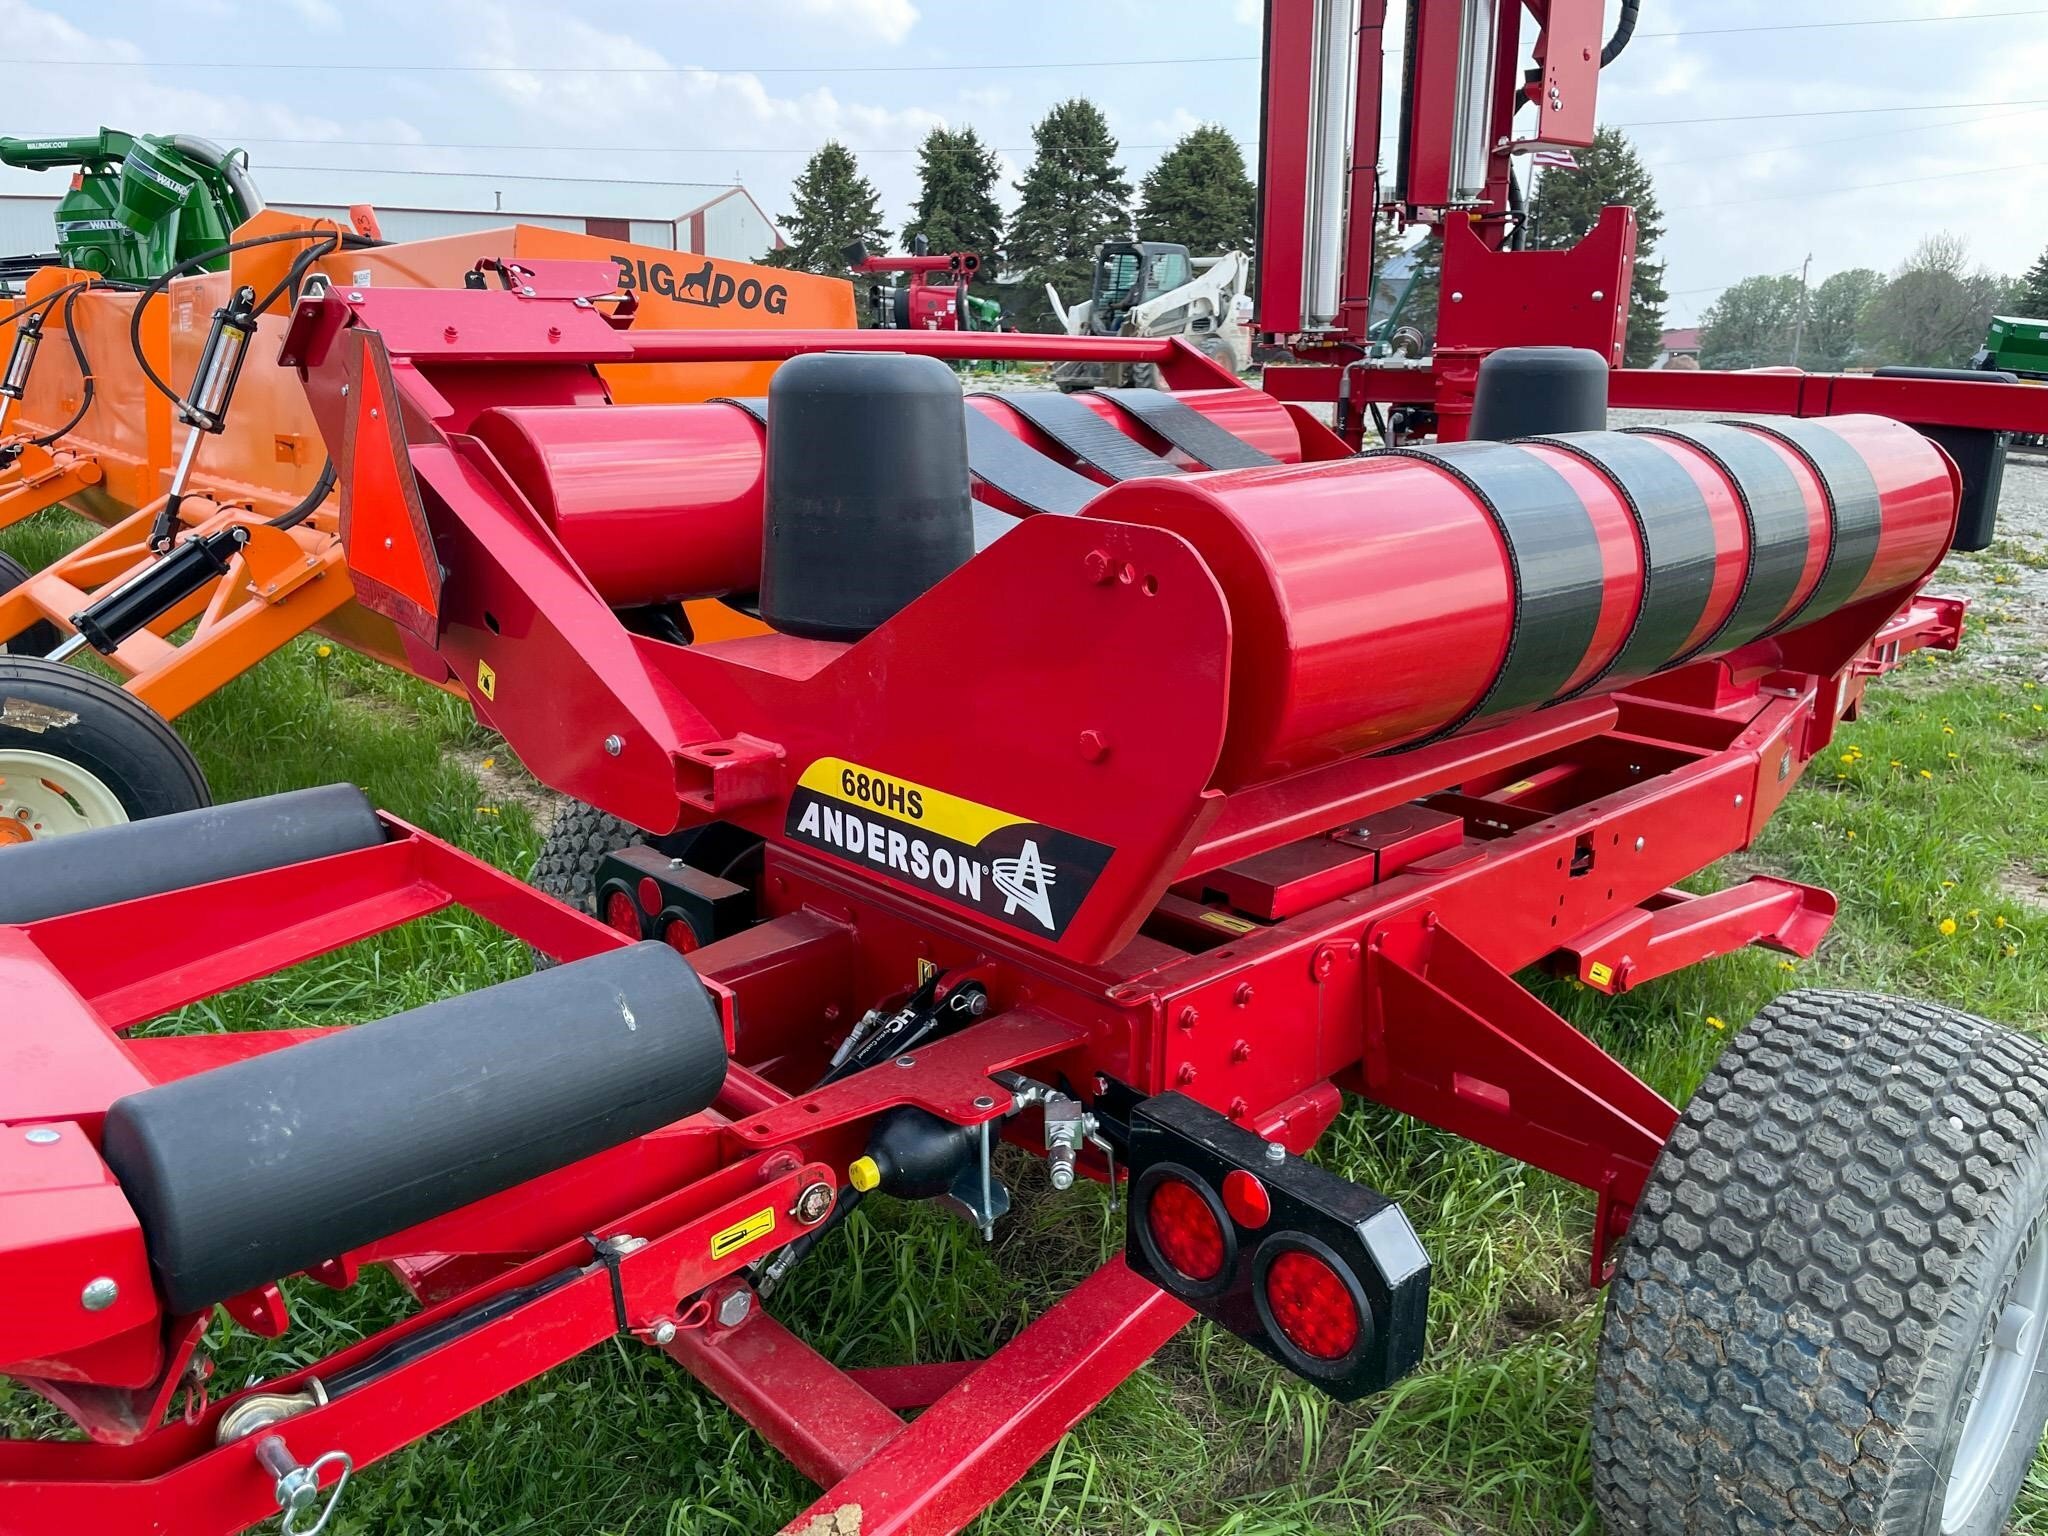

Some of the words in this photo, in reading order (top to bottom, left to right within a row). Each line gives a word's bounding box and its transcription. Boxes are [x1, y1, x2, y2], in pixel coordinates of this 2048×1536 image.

[610, 255, 675, 297] BIG
[711, 273, 788, 315] DOG
[841, 768, 924, 820] 680HS
[885, 1008, 916, 1034] HC
